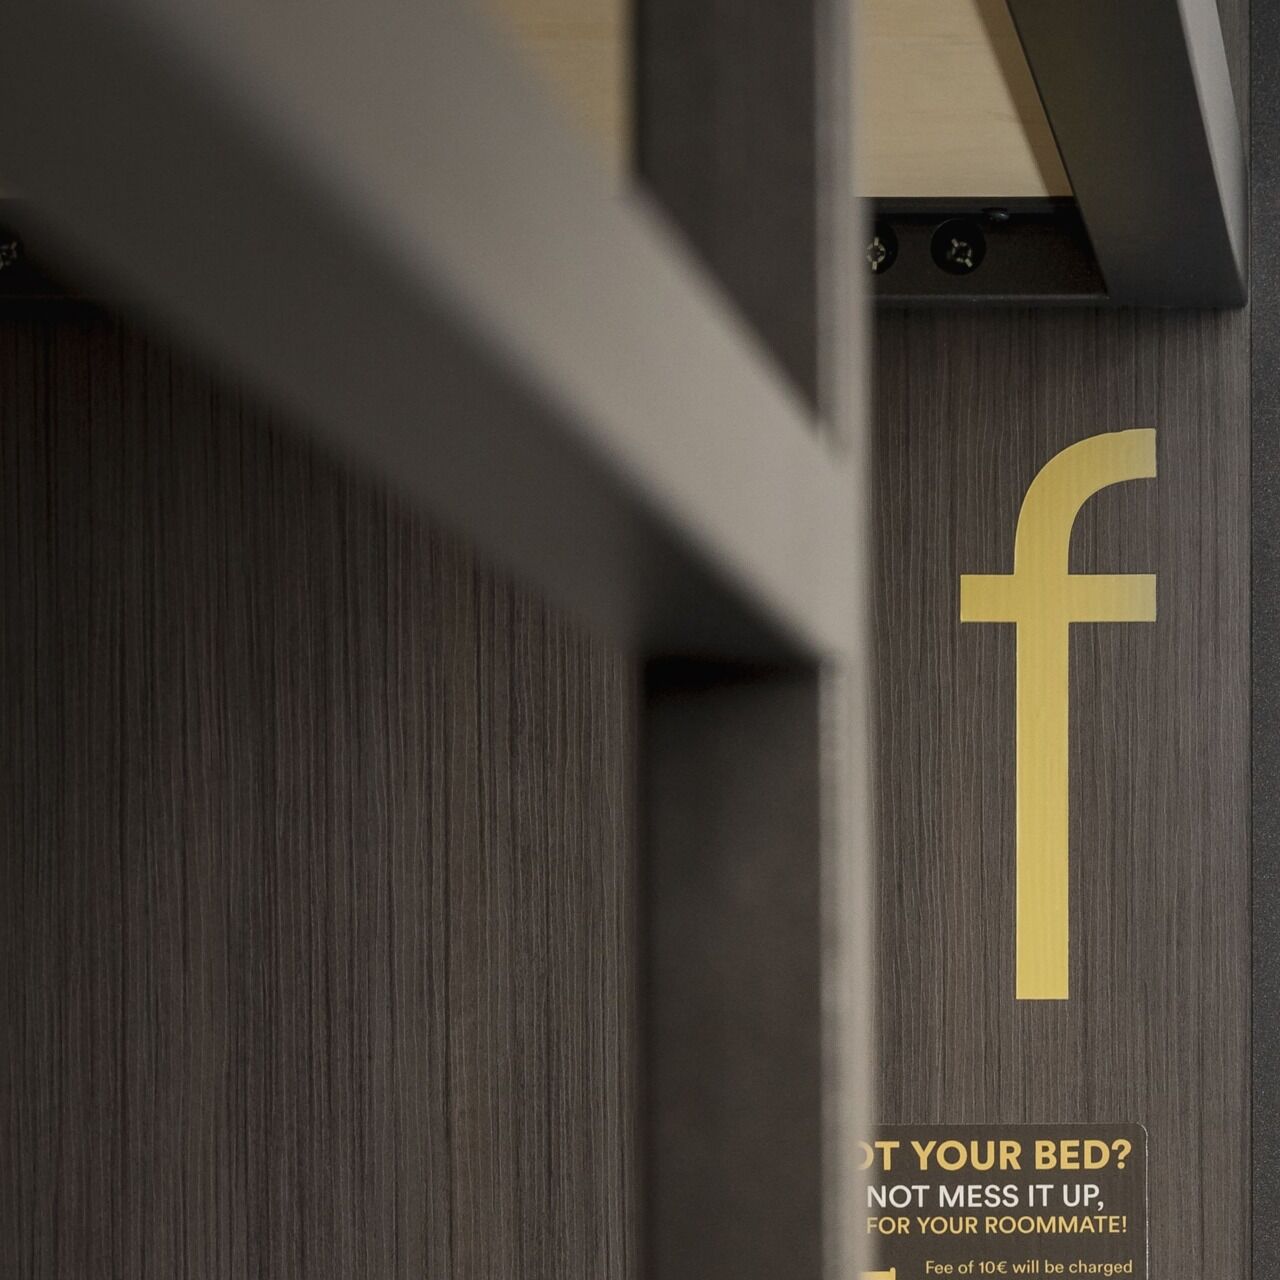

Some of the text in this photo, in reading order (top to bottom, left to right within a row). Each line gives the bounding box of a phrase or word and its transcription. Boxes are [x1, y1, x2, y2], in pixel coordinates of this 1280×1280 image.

[960, 428, 1157, 1000] f
[857, 1139, 1131, 1171] OT YOUR BED?
[867, 1184, 1103, 1211] NOT MESS IT UP,
[867, 1216, 1126, 1234] FOR YOUR ROOMMATE!
[926, 1260, 1132, 1276] Fee of 10€ will be charged
